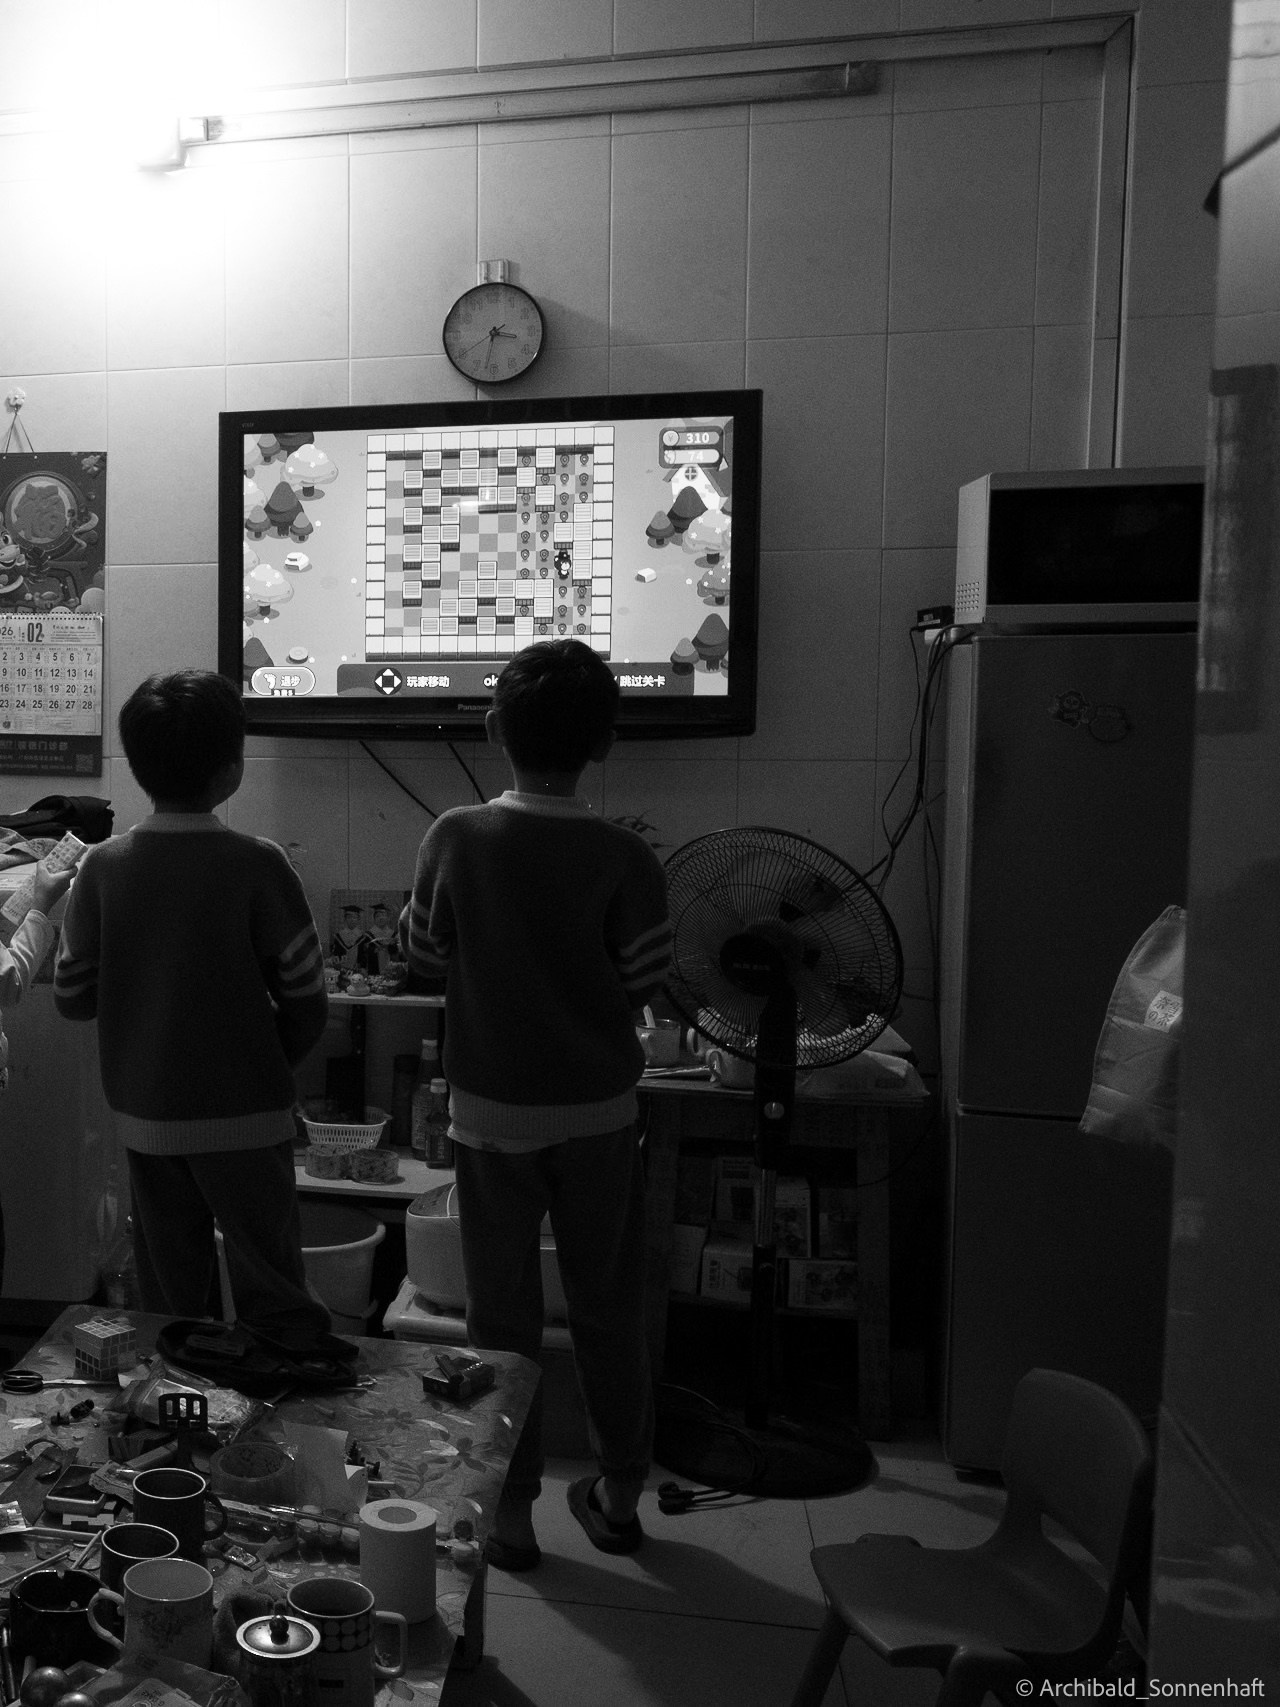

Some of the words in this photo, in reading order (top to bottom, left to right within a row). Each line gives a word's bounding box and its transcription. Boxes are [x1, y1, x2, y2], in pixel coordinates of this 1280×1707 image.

[686, 432, 709, 444] 310
[688, 450, 703, 462] 74
[27, 622, 44, 642] 02
[2, 652, 8, 661] 2
[19, 652, 24, 661] 3
[36, 652, 41, 660] 4
[53, 652, 58, 661] 5
[69, 653, 75, 662] 6
[86, 653, 91, 661] 7
[2, 668, 7, 676] 9
[16, 668, 27, 677] 10
[34, 668, 43, 676] 11
[50, 668, 60, 677] 12
[67, 669, 77, 678] 13
[84, 669, 93, 677] 14
[280, 675, 301, 687] 退步
[406, 676, 449, 688] 玩家移动
[483, 674, 499, 687] ok
[619, 675, 666, 688] 跳过关卡
[0, 684, 10, 692] 16
[17, 684, 27, 692] 17
[33, 684, 43, 693] 18
[50, 684, 60, 693] 19
[66, 684, 76, 694] 20
[83, 685, 93, 694] 21
[0, 699, 9, 708] 23
[16, 699, 26, 708] 24
[32, 700, 43, 709] 25
[49, 700, 59, 709] 26
[65, 700, 76, 709] 27
[82, 701, 93, 710] 28
